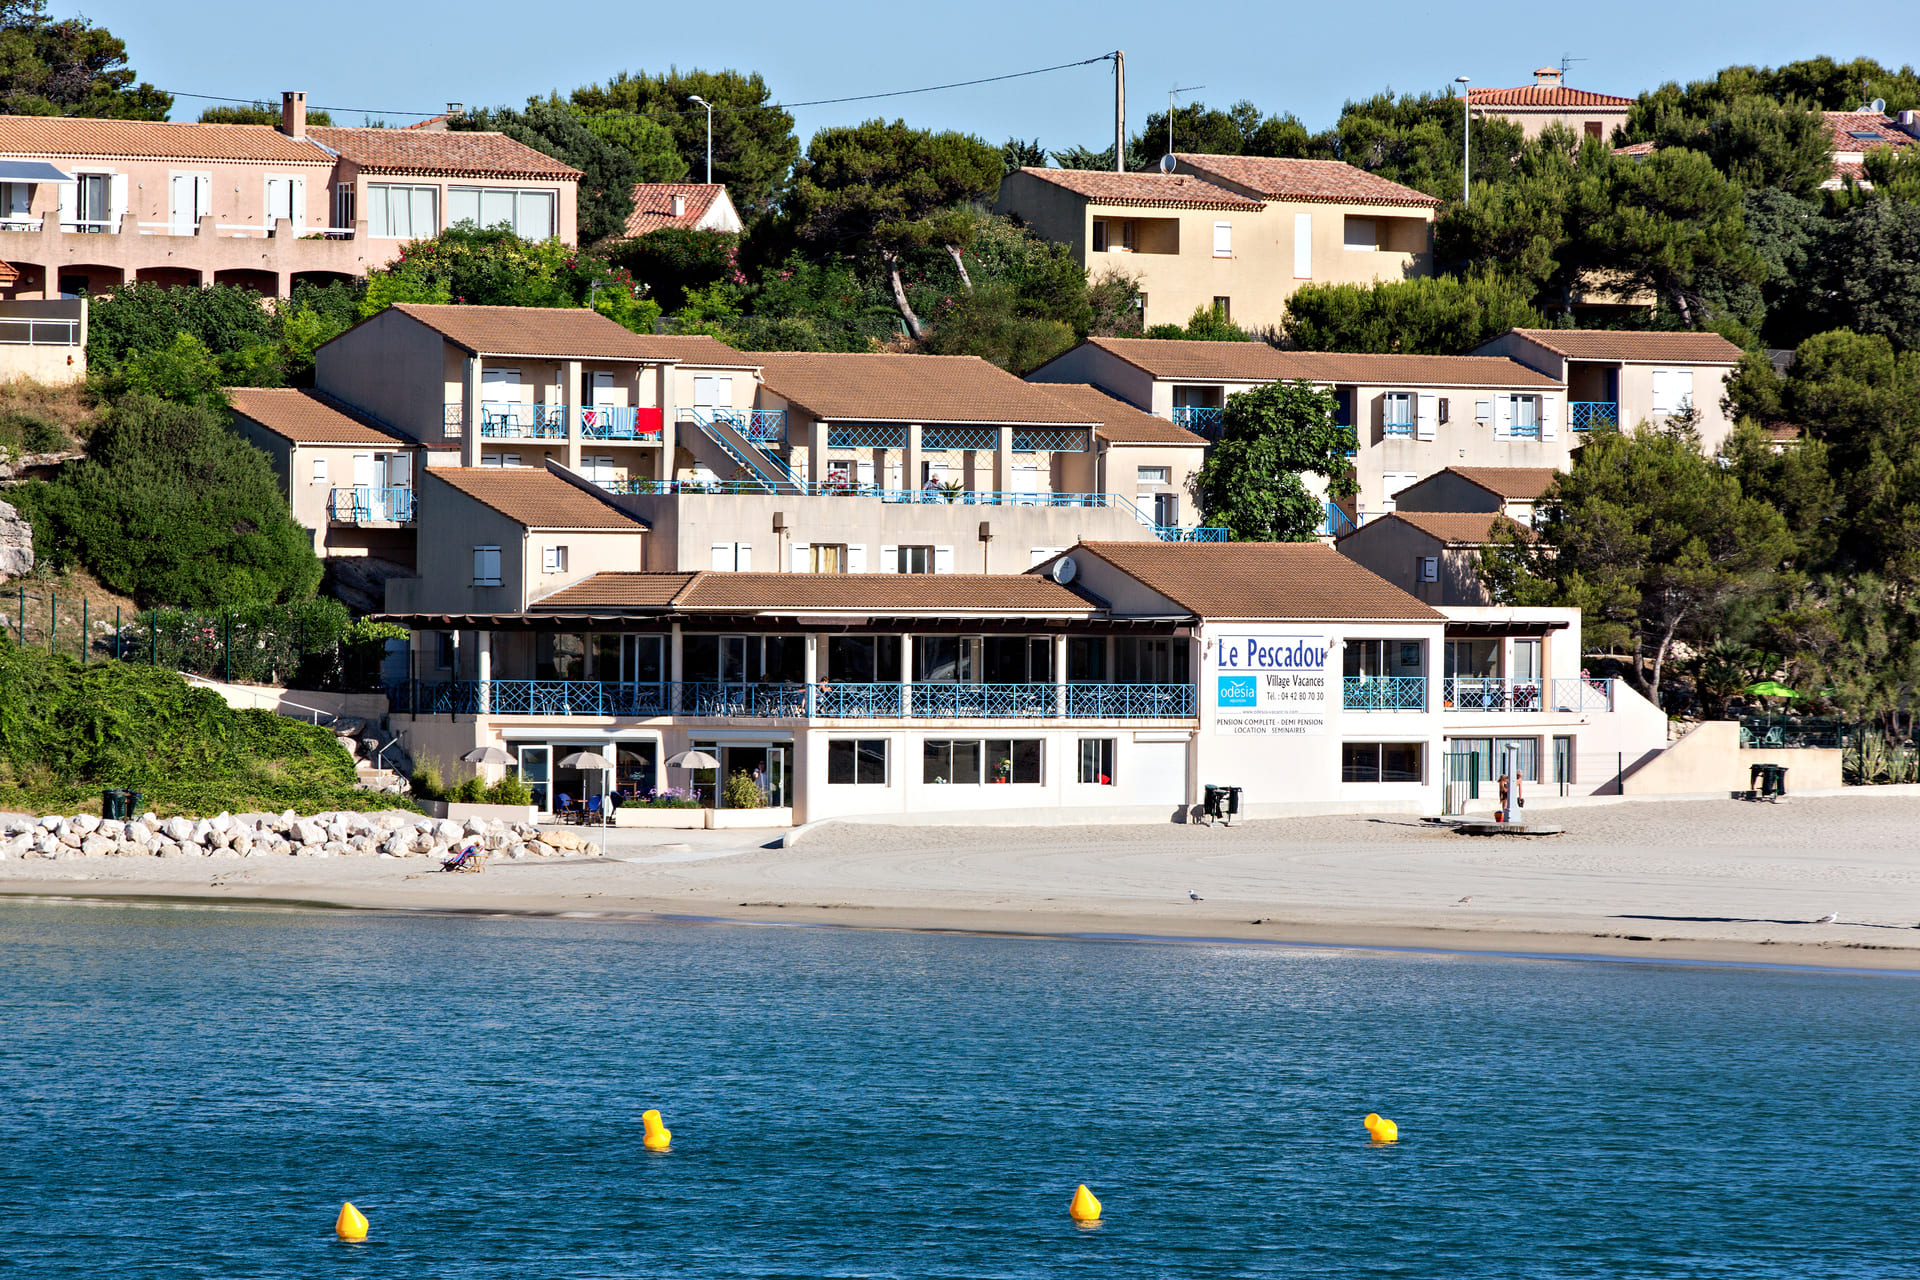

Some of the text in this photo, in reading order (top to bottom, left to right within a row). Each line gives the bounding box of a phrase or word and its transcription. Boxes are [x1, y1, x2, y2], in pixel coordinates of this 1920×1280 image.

[1218, 638, 1324, 667] Le Pescadou
[1266, 674, 1324, 688] Village Vacances
[1281, 692, 1288, 701] 04
[1290, 692, 1297, 701] 42
[1299, 692, 1307, 701] 80
[1308, 692, 1315, 701] 70
[1316, 692, 1324, 701] 30
